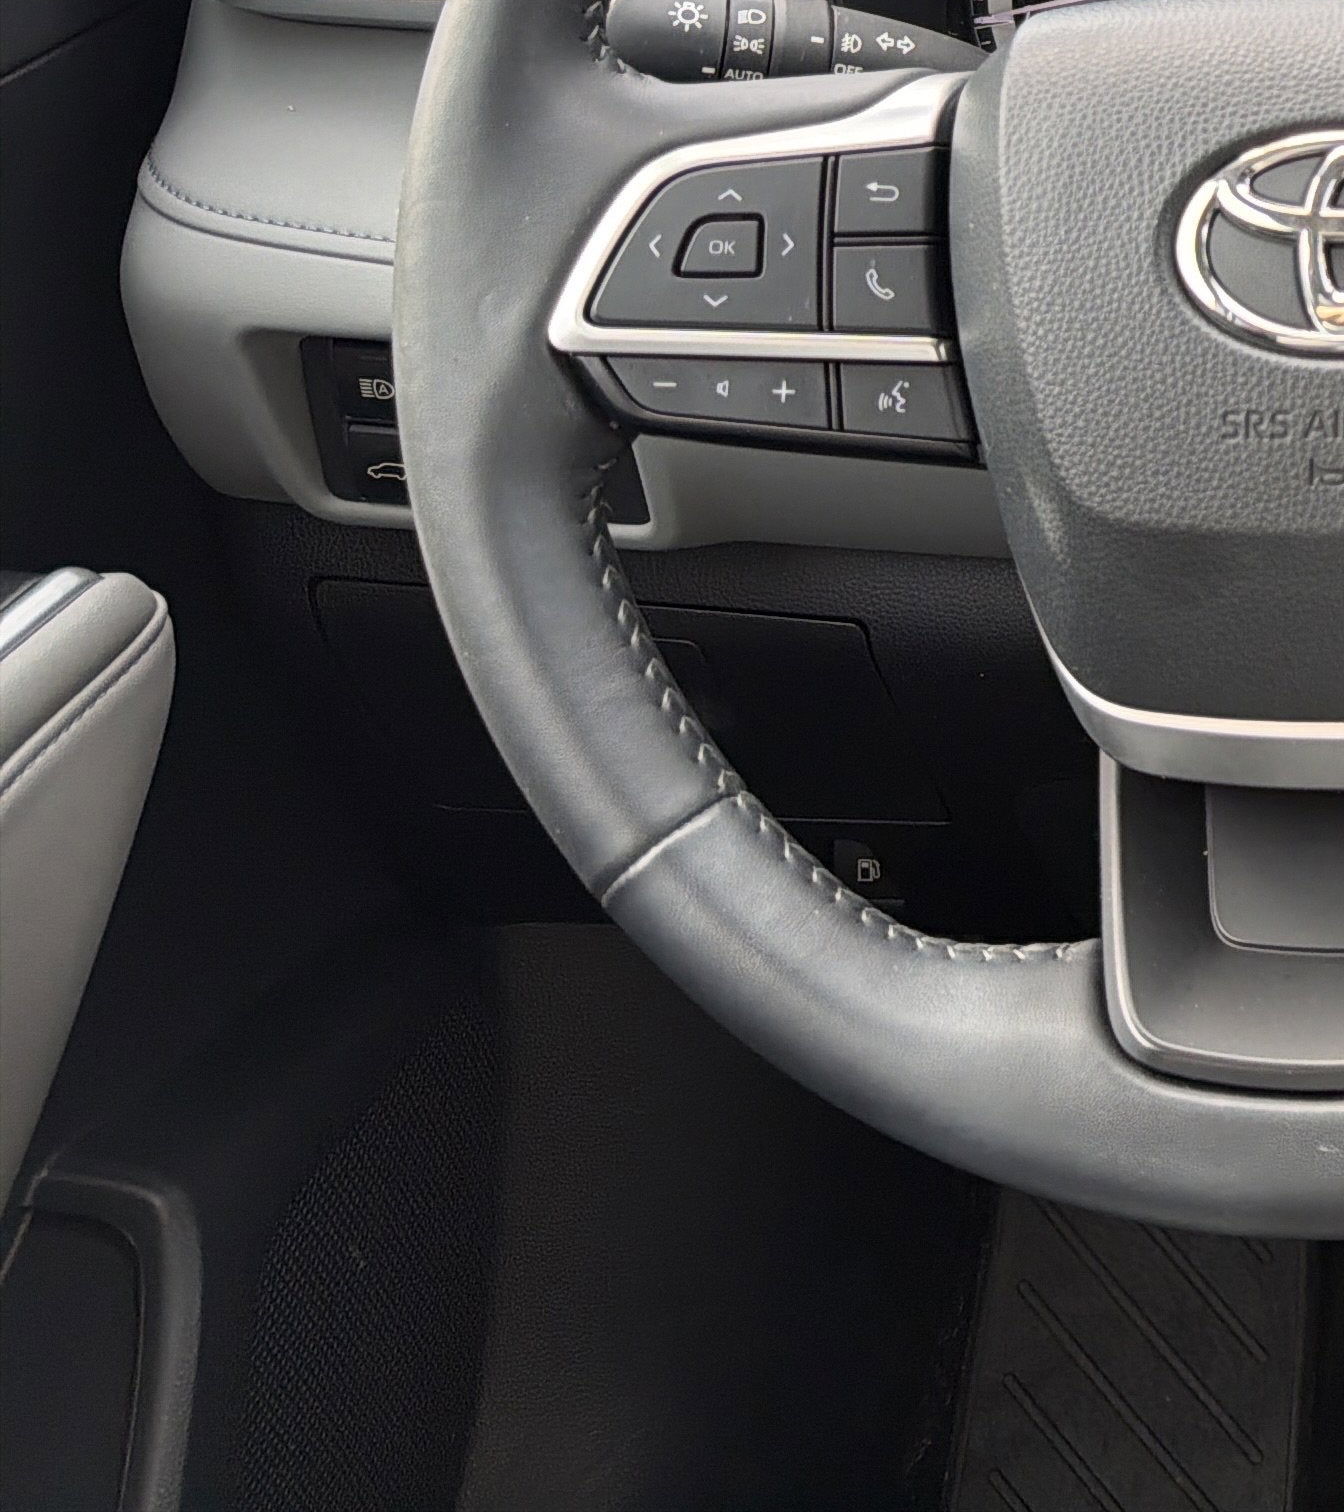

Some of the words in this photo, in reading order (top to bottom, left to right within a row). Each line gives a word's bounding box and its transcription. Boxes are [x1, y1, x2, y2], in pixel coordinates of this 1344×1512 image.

[725, 68, 763, 81] AUTO
[834, 64, 863, 75] OFF
[708, 240, 735, 255] OK
[1221, 410, 1290, 440] SRS
